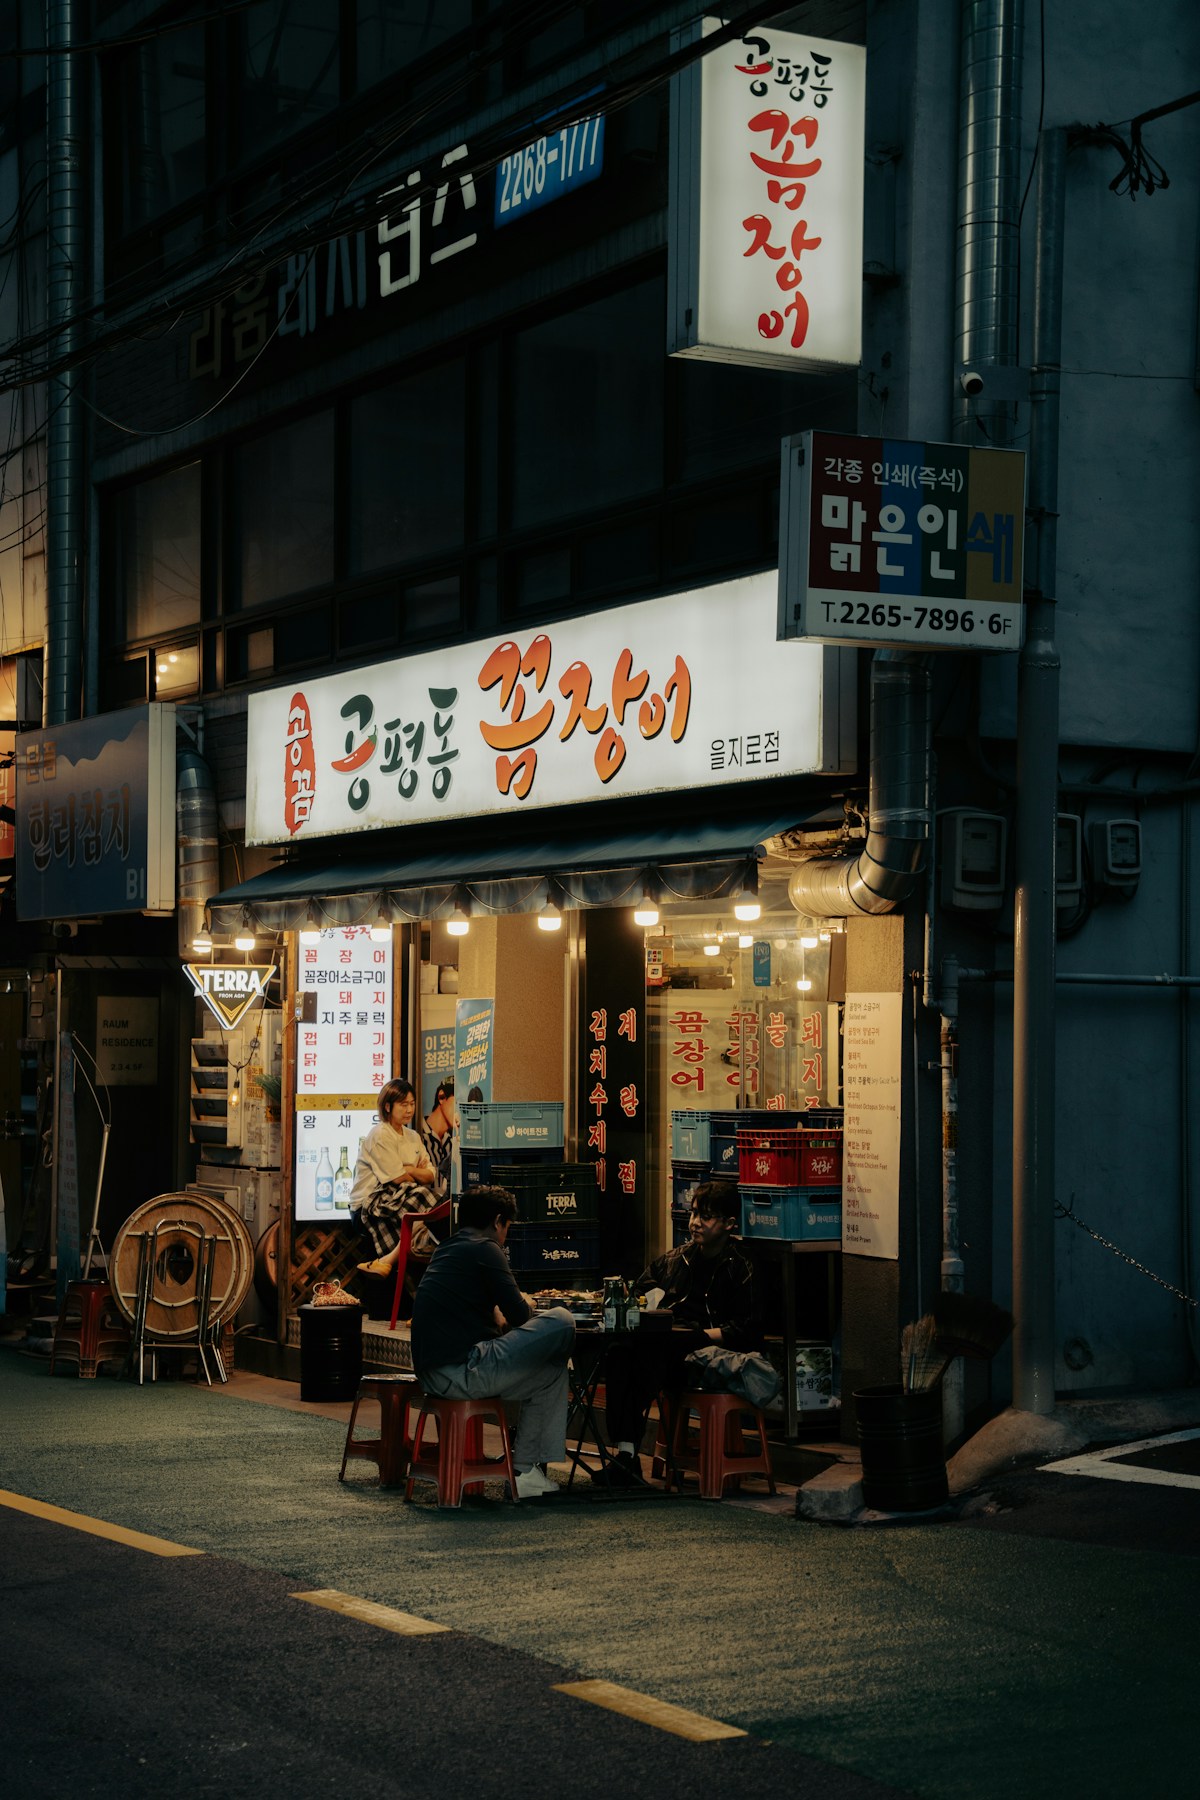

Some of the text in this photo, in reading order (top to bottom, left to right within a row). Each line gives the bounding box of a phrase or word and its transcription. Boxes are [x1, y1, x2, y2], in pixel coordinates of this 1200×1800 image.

[734, 36, 834, 109] 공평동
[500, 111, 601, 214] 2268-1777
[742, 109, 822, 348] 꼼장어
[824, 457, 964, 493] 각종 인쇄(즉석)
[821, 494, 1014, 584] 맑은인쇄
[478, 634, 691, 799] 꼼장어
[285, 706, 315, 825] 공꼼
[331, 687, 459, 811] 공평동
[709, 731, 780, 770] 을지로점
[198, 969, 264, 996] TERRA
[304, 970, 386, 984] 꼼장어소금구이
[102, 1019, 129, 1029] RAUM
[102, 1038, 154, 1047] RESIDENCE
[425, 1035, 437, 1051] 이
[617, 1007, 639, 1194] 계란찜
[516, 1127, 549, 1136] 하이트진로
[811, 1159, 832, 1175] 청하
[546, 1194, 577, 1209] TERRA
[816, 1215, 841, 1224] 하이트진
